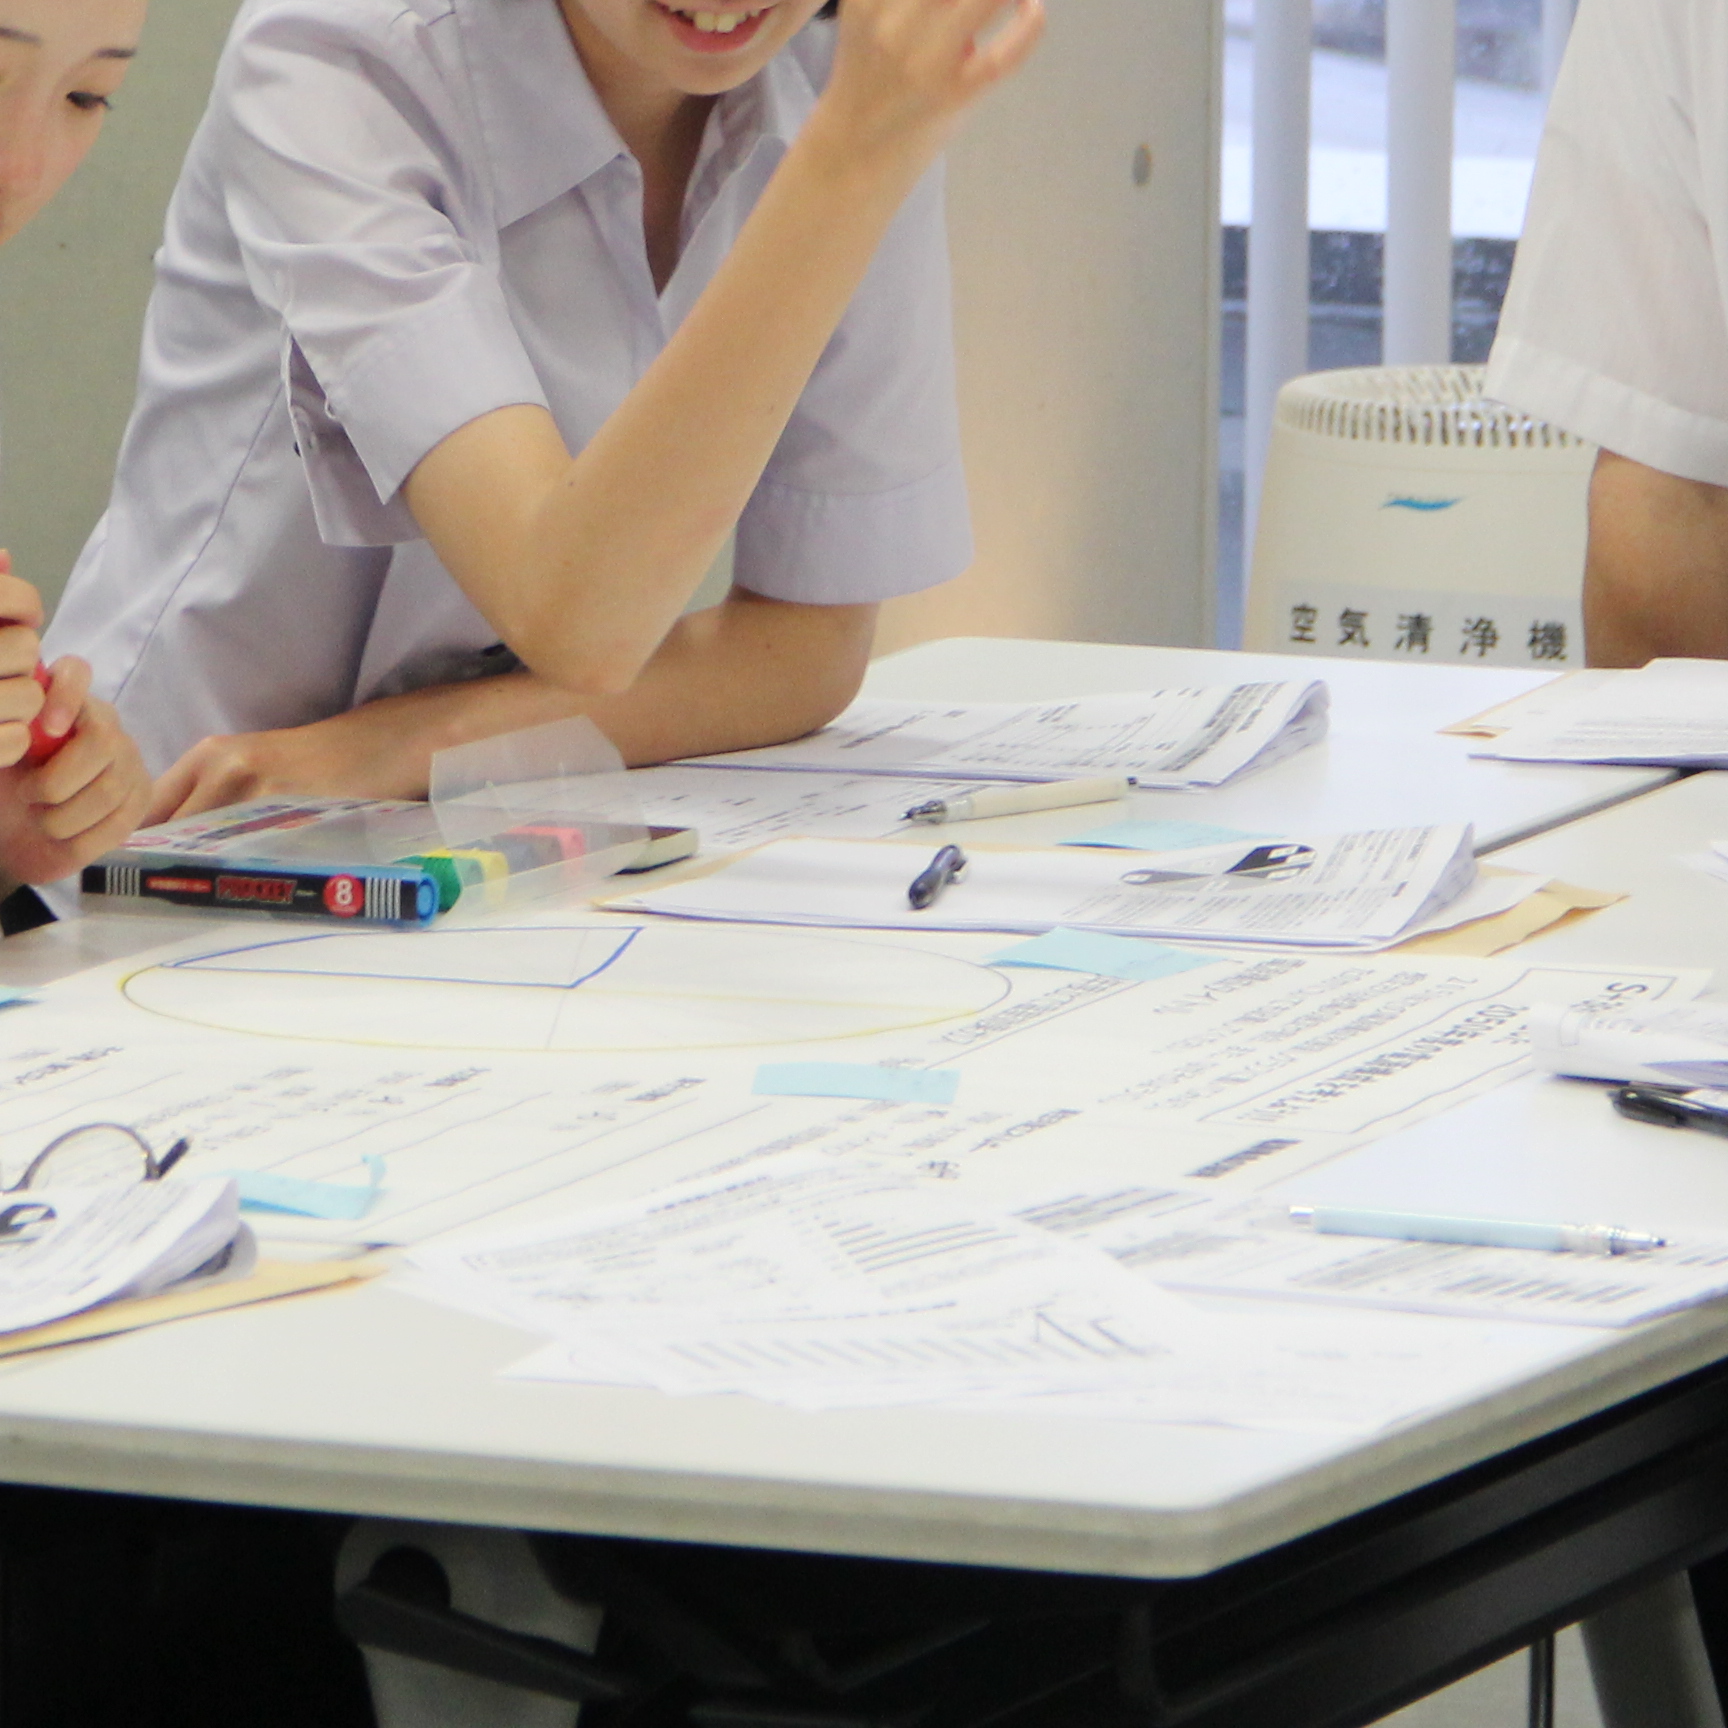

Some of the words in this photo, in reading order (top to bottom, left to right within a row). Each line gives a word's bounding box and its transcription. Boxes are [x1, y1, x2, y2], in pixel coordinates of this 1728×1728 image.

[1289, 603, 1568, 661] 空気清浄機
[335, 878, 354, 905] 8
